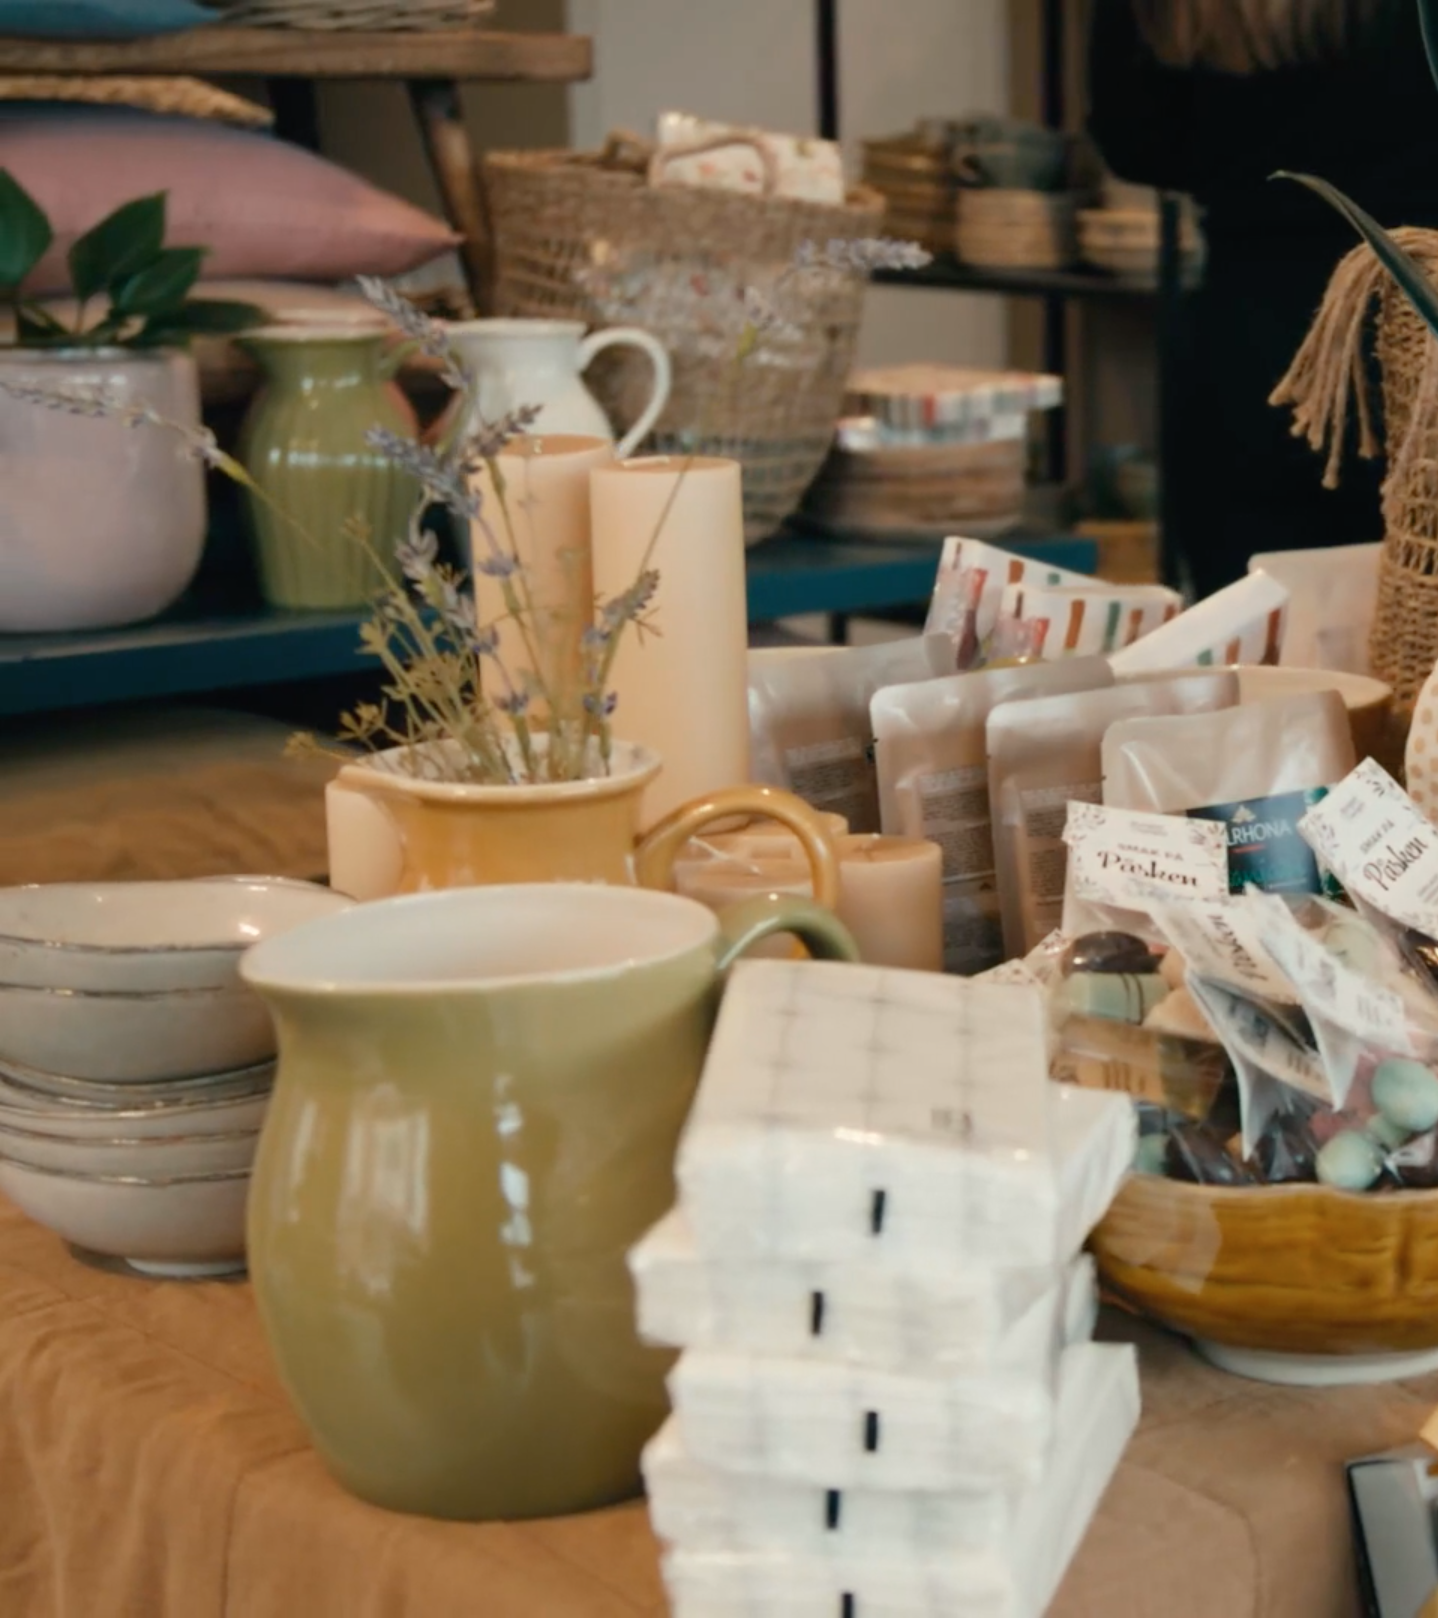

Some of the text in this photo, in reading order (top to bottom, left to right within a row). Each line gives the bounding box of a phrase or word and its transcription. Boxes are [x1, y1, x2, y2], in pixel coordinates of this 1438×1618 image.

[1227, 820, 1293, 847] LRHONA
[1097, 849, 1198, 888] Påsken
[1362, 836, 1430, 892] Påsken
